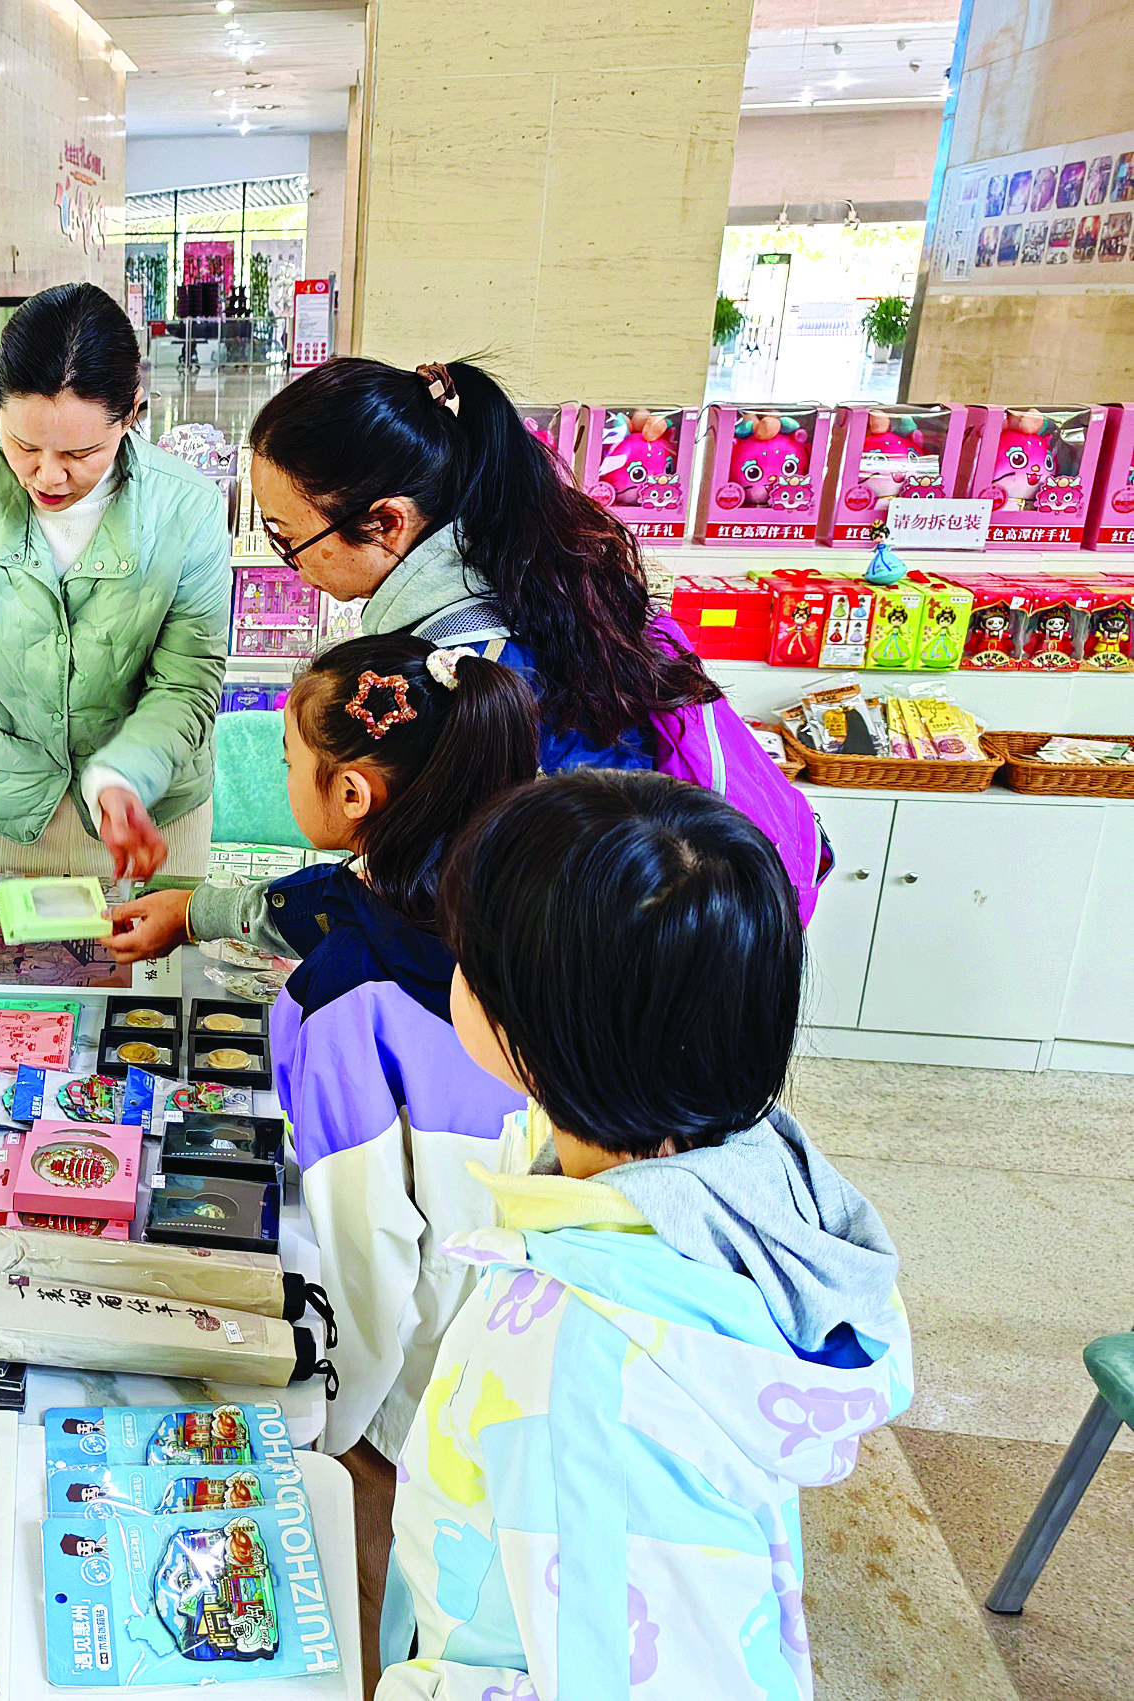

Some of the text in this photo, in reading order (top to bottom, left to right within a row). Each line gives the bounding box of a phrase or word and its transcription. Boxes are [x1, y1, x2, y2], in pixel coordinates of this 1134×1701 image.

[718, 524, 806, 539] 红色高潭伴手礼
[893, 513, 983, 531] 请勿拆包装
[275, 1502, 338, 1673] HUIZHOU
[95, 1609, 107, 1651] 木质冰箱贴
